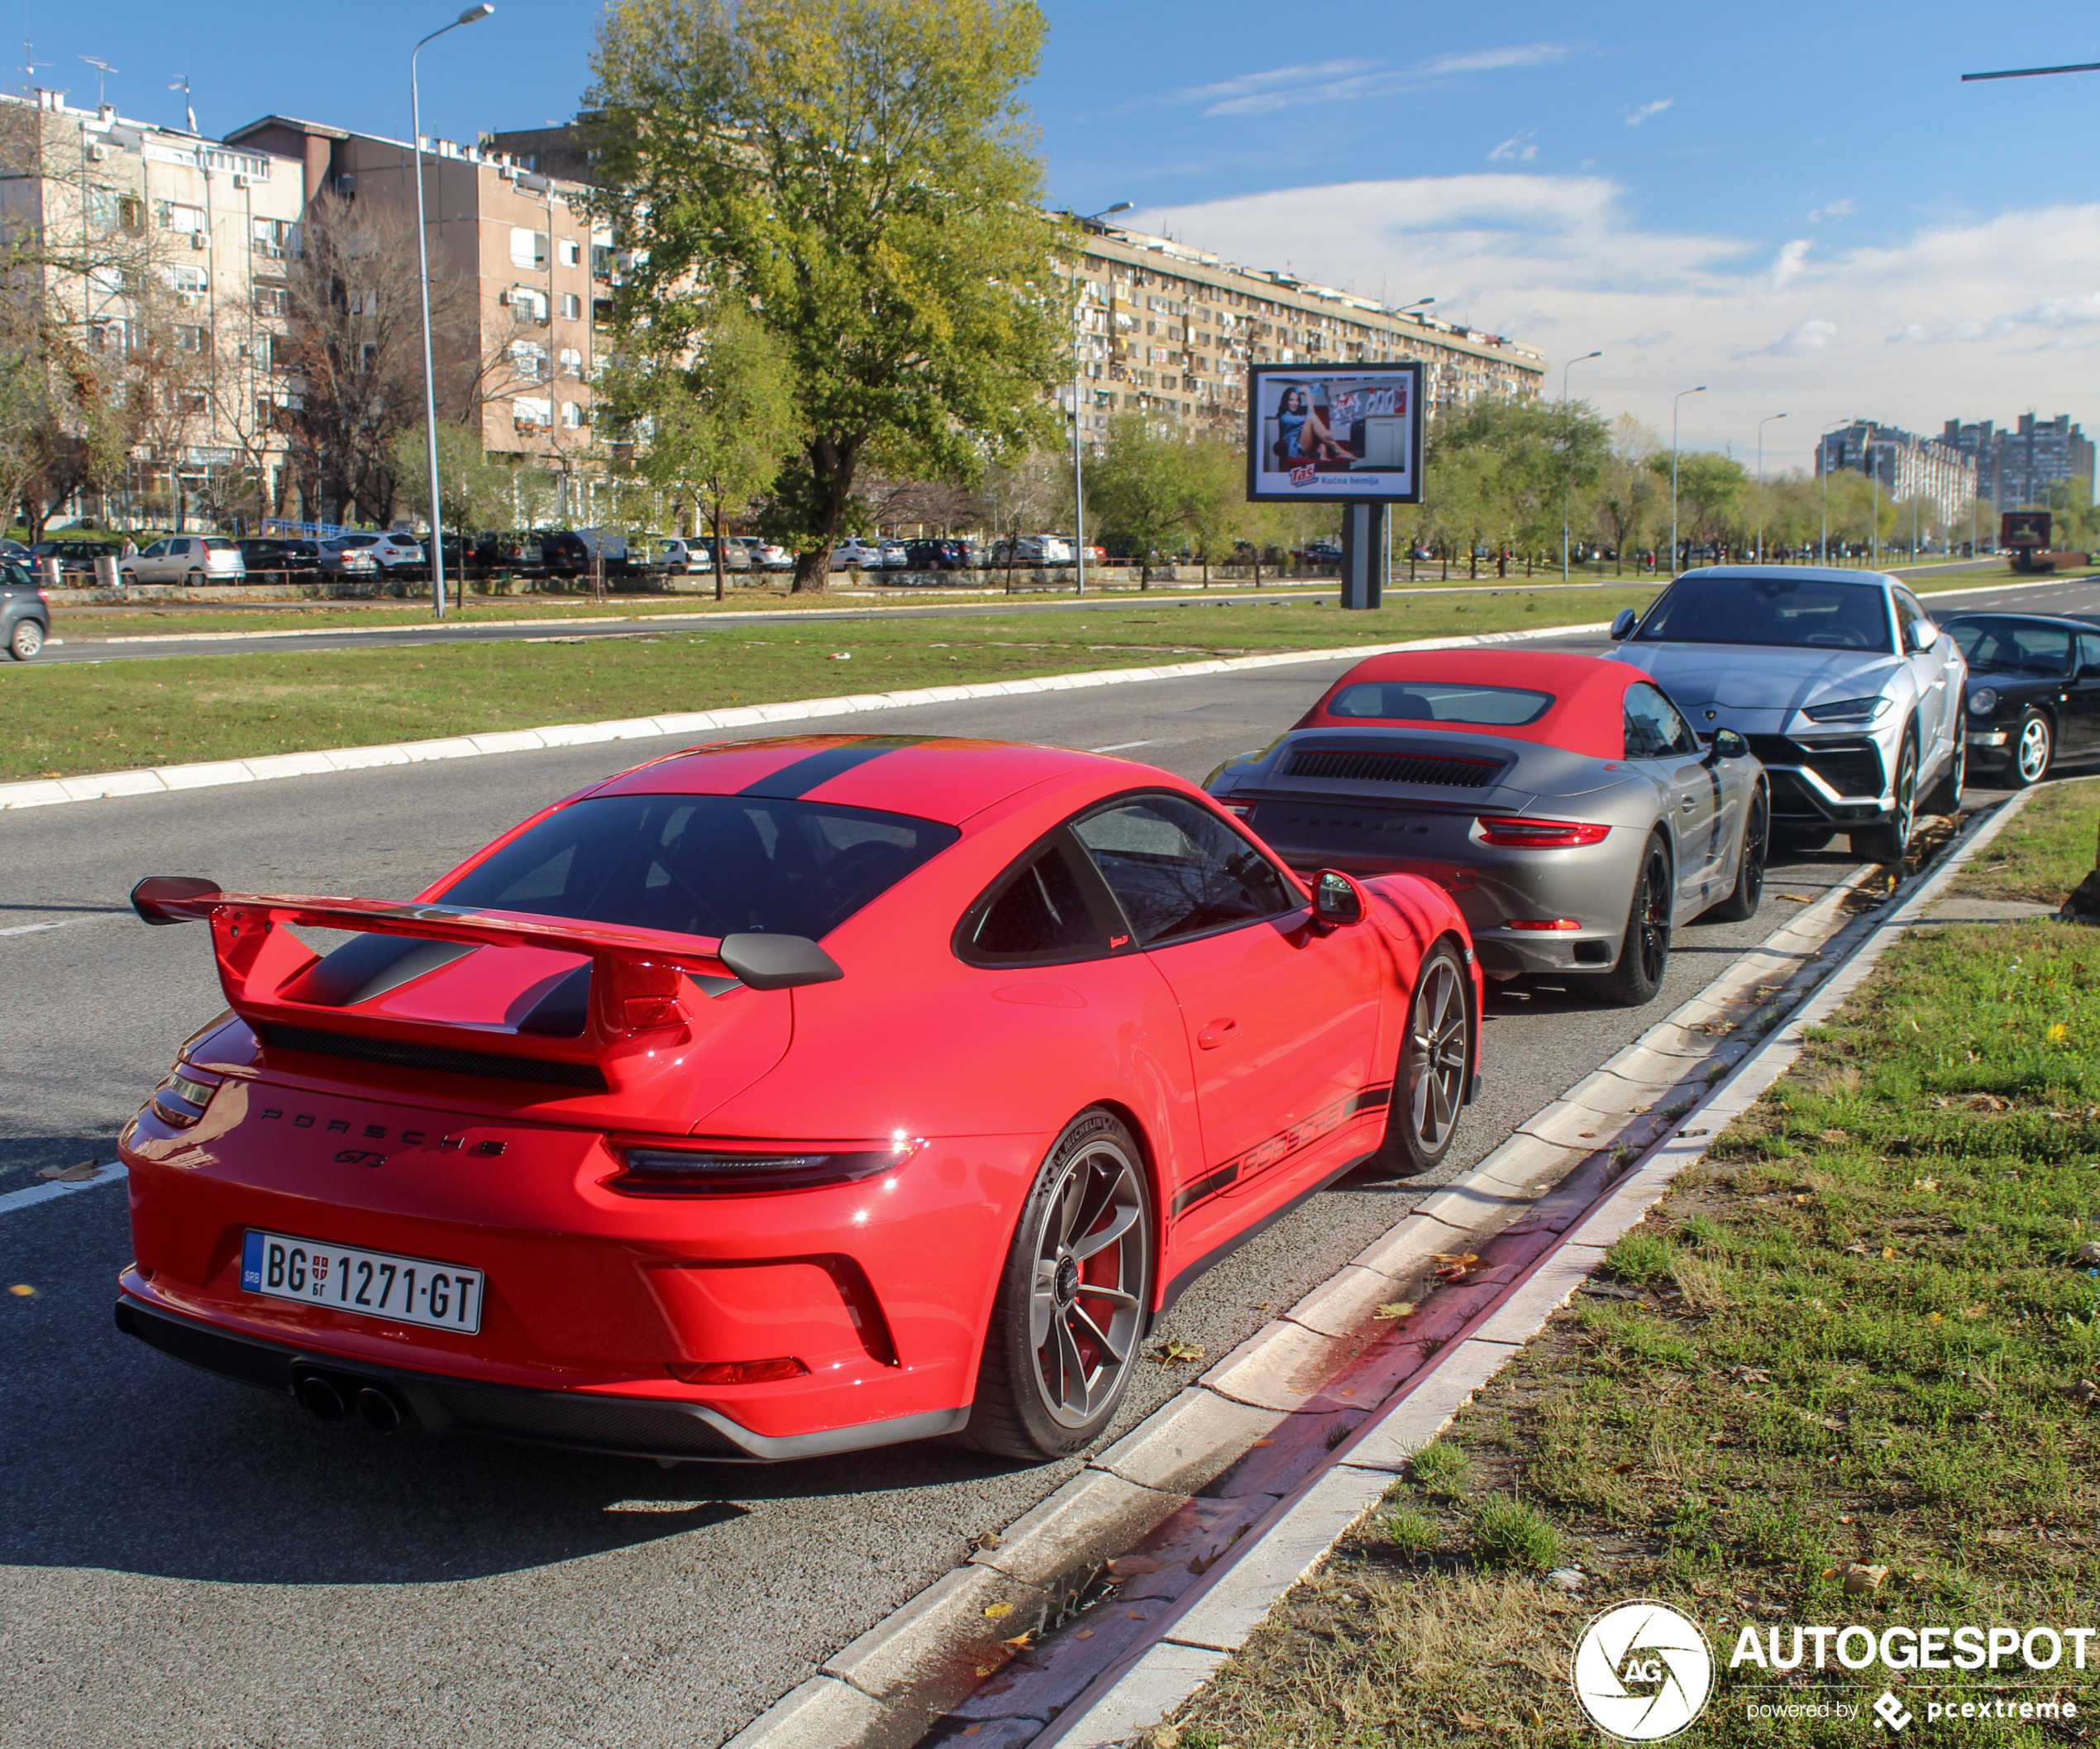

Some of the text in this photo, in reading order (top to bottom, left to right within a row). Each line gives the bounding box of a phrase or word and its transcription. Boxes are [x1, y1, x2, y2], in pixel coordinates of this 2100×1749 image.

[1350, 476, 1379, 486] hemija
[260, 1108, 508, 1155] PORSCHE
[1064, 1117, 1103, 1153] MICHELIN
[1242, 1106, 1340, 1178] PORSCHE
[333, 1149, 389, 1168] GT3
[245, 1271, 260, 1283] SRB
[267, 1243, 307, 1292] BG
